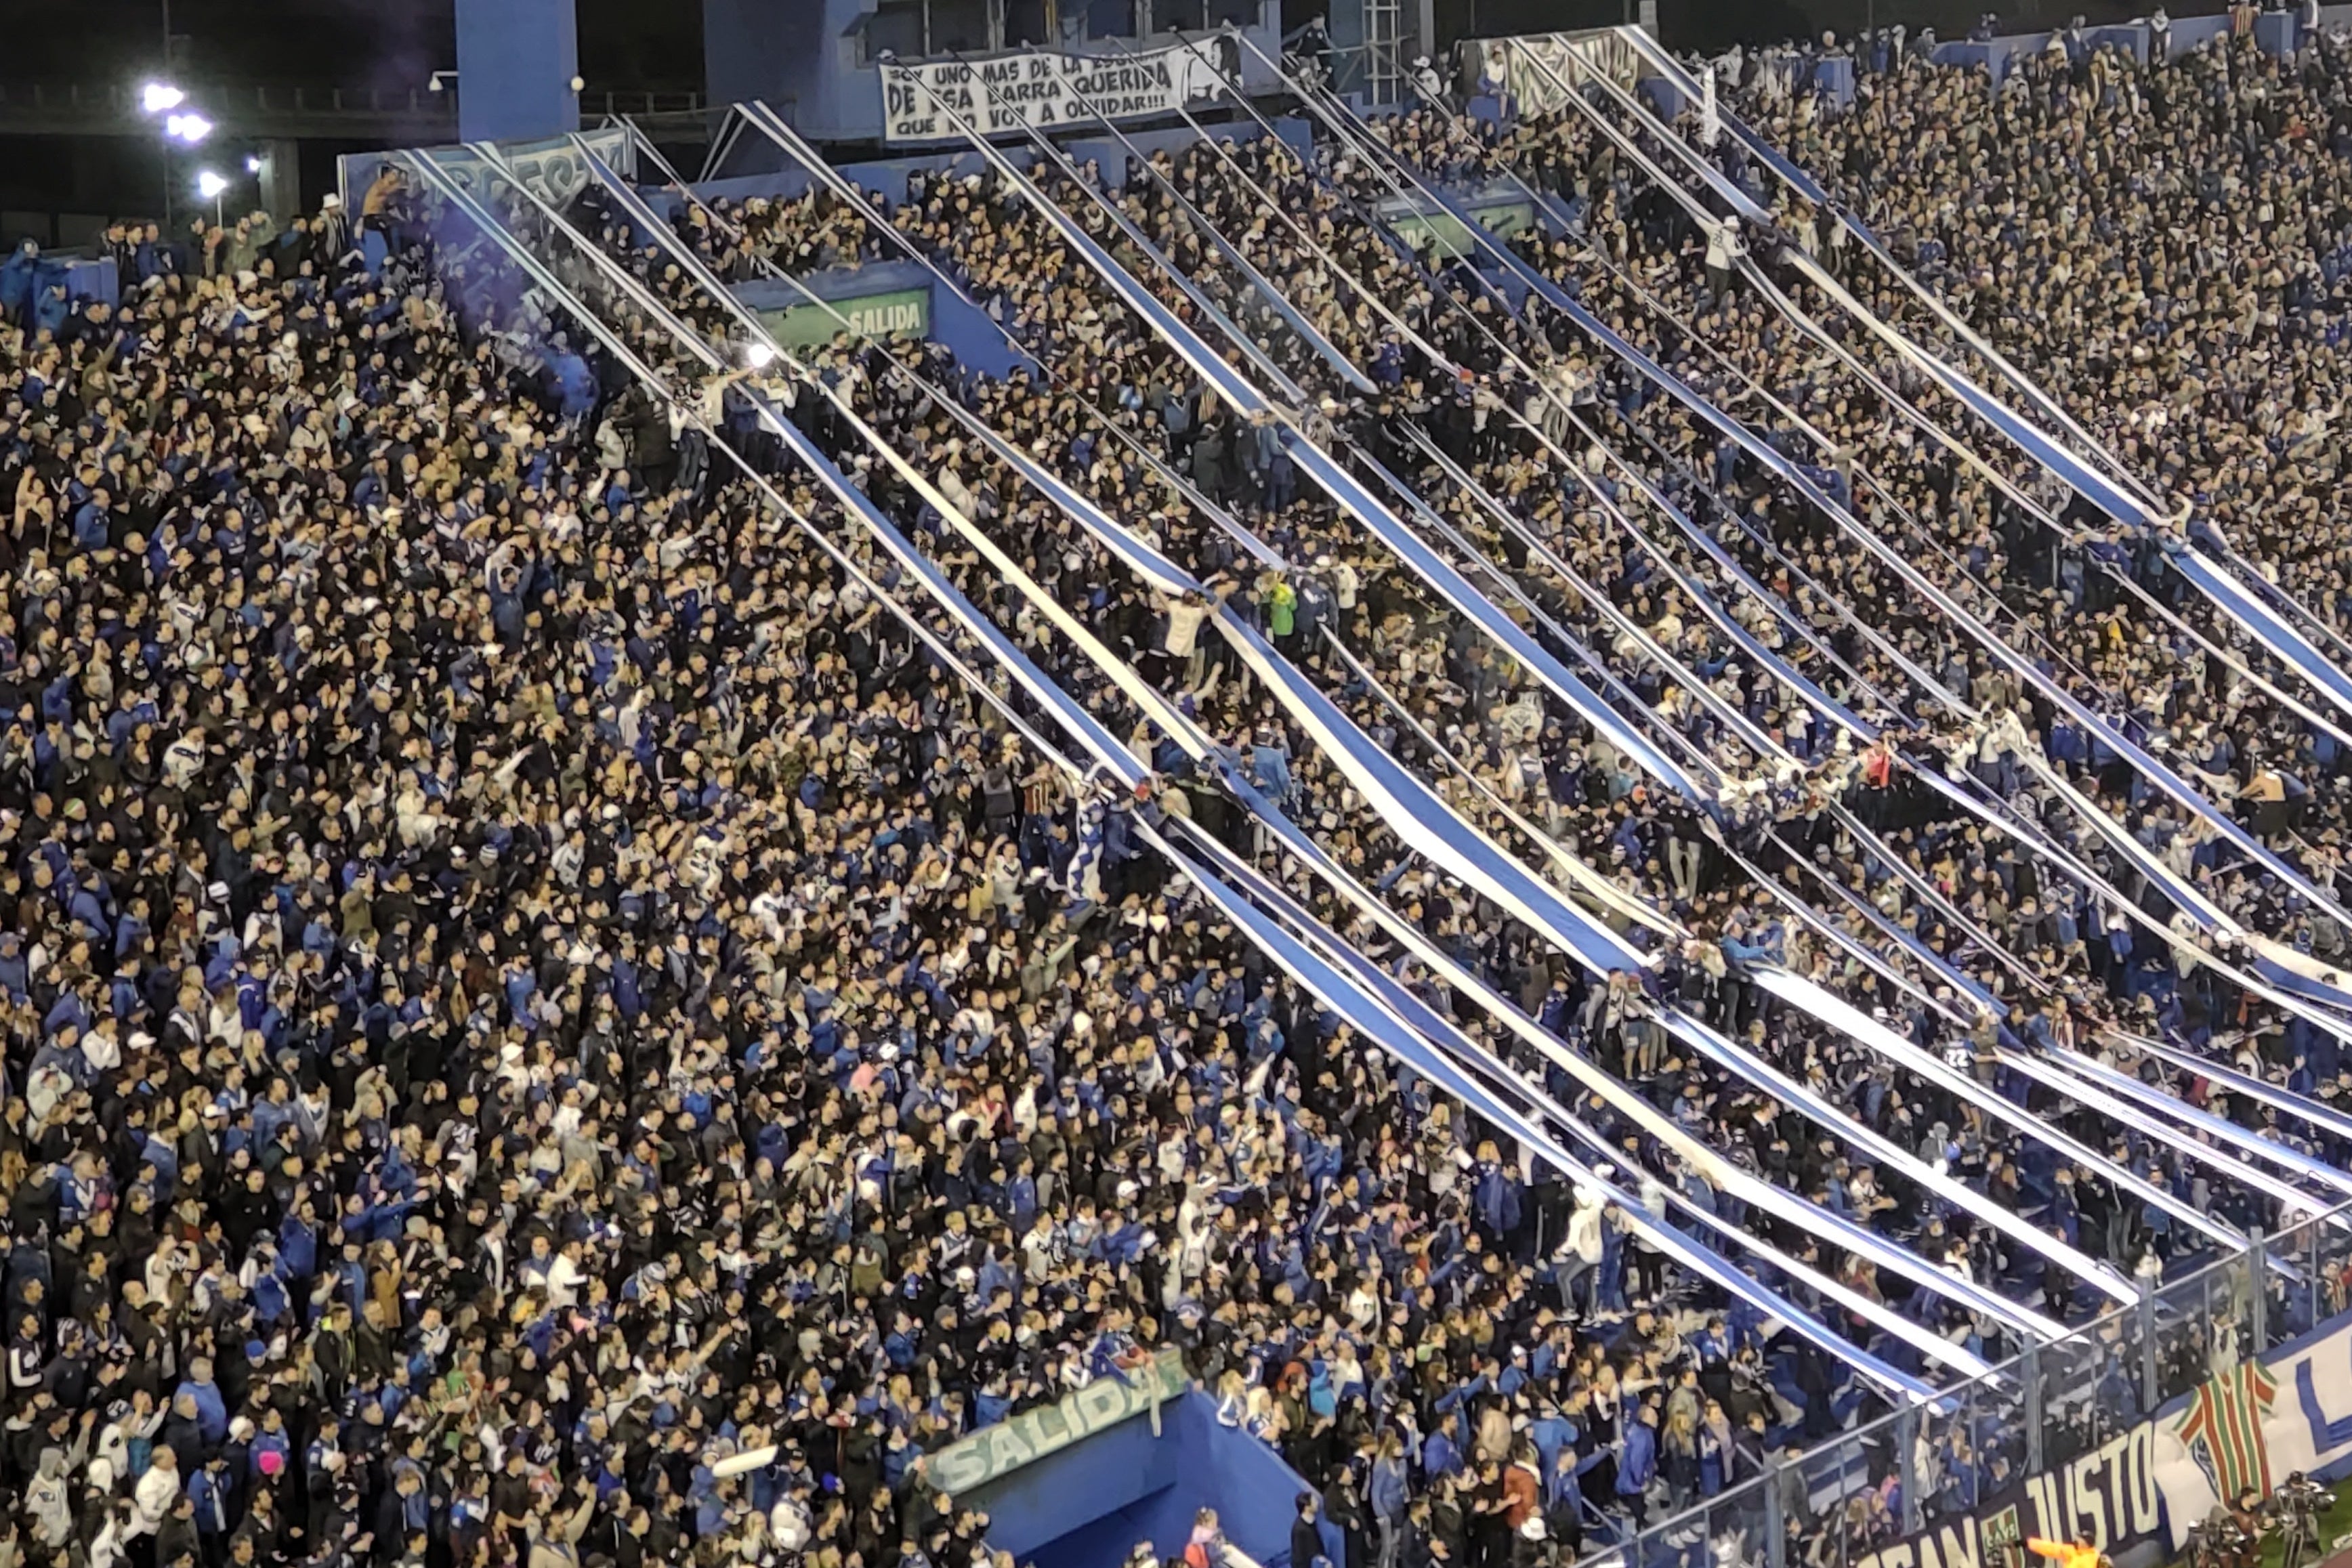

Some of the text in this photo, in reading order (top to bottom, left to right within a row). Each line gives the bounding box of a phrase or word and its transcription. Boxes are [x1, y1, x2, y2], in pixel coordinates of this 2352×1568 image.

[887, 83, 916, 117] DE
[1074, 61, 1172, 94] QUERIDA
[935, 66, 971, 84] UNO
[984, 61, 1019, 83] MAS
[1030, 57, 1051, 79] DE
[1062, 56, 1082, 74] LA
[897, 118, 936, 135] QUE
[1041, 102, 1055, 123] A
[849, 302, 921, 336] SALIDA
[936, 1367, 1171, 1489] SALIDA
[2025, 1420, 2159, 1565] JUSTO
